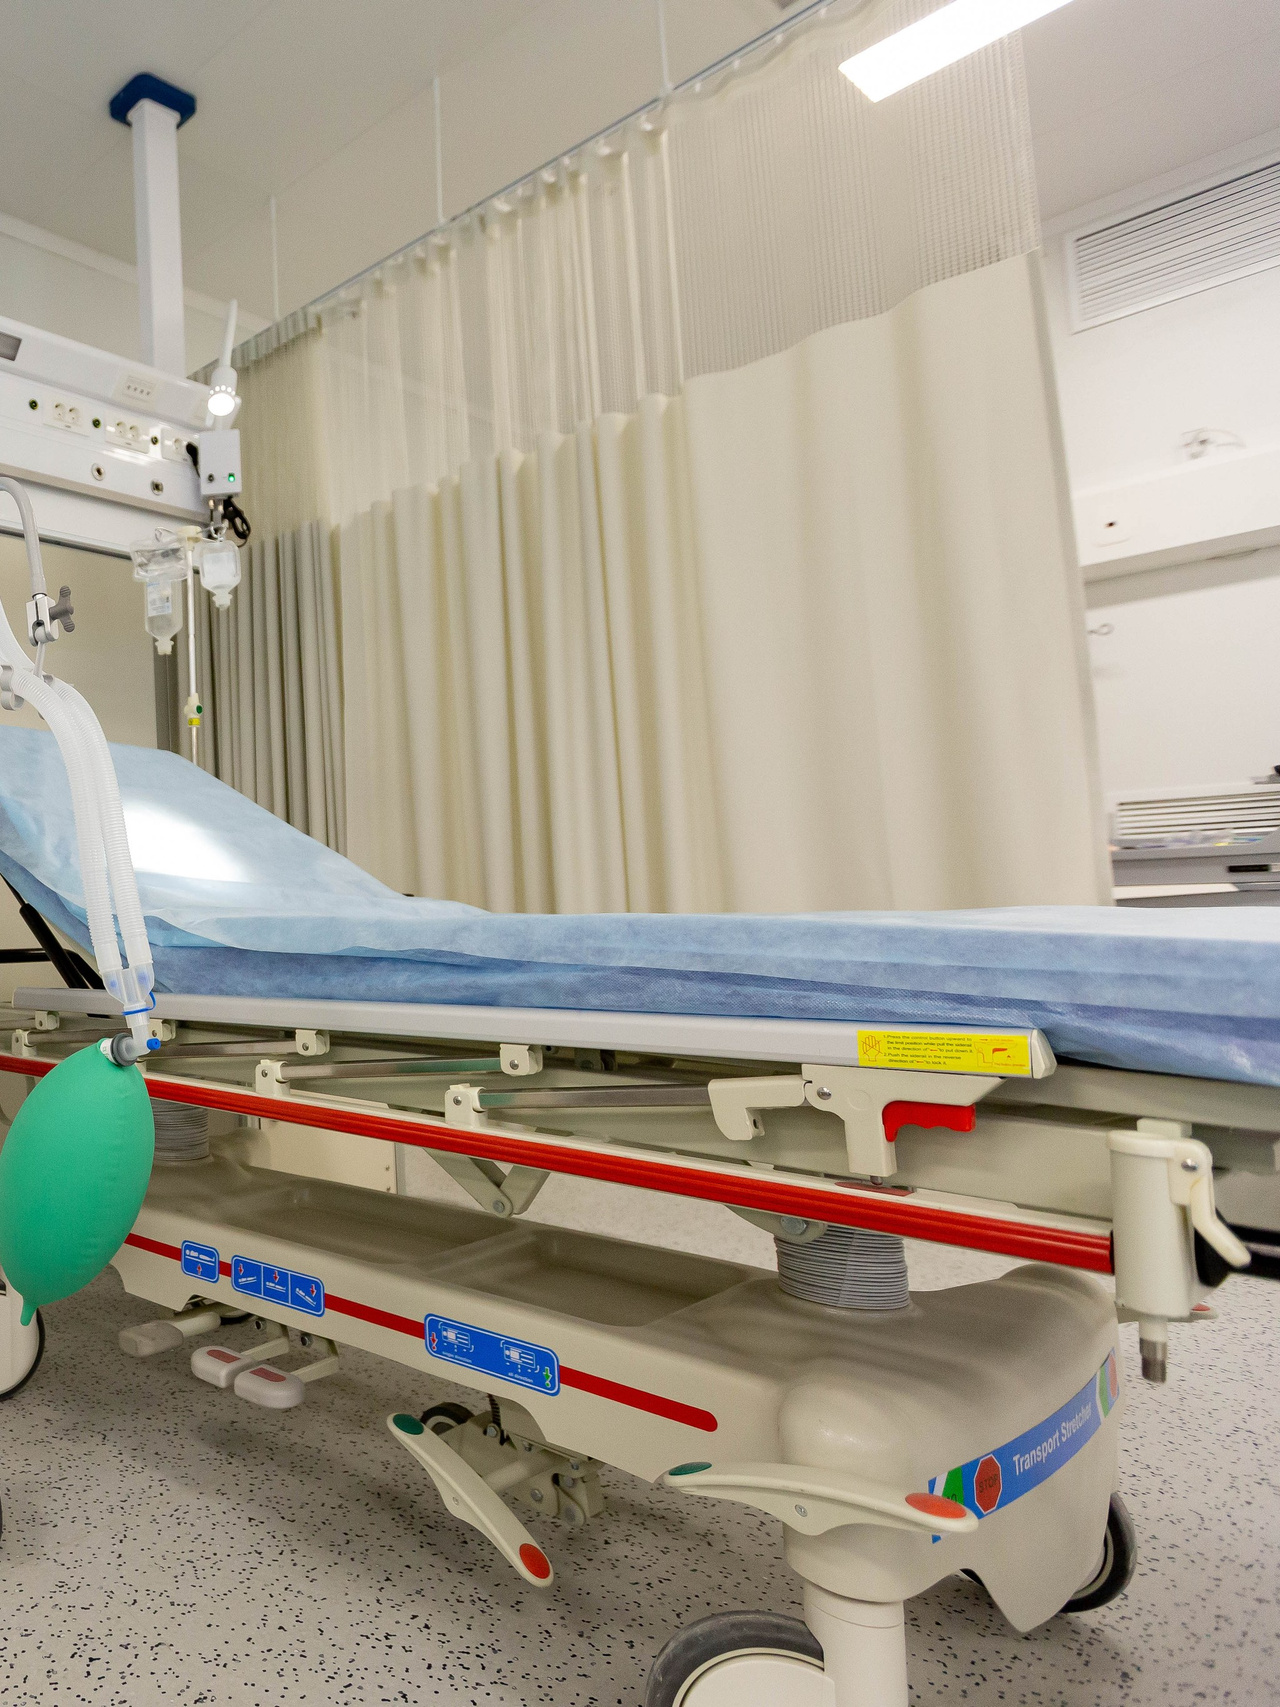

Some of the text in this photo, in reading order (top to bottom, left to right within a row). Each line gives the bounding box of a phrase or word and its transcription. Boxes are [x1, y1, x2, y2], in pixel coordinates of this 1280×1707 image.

[1013, 1401, 1092, 1476] Transport Stretcher
[979, 1473, 998, 1494] STOP
